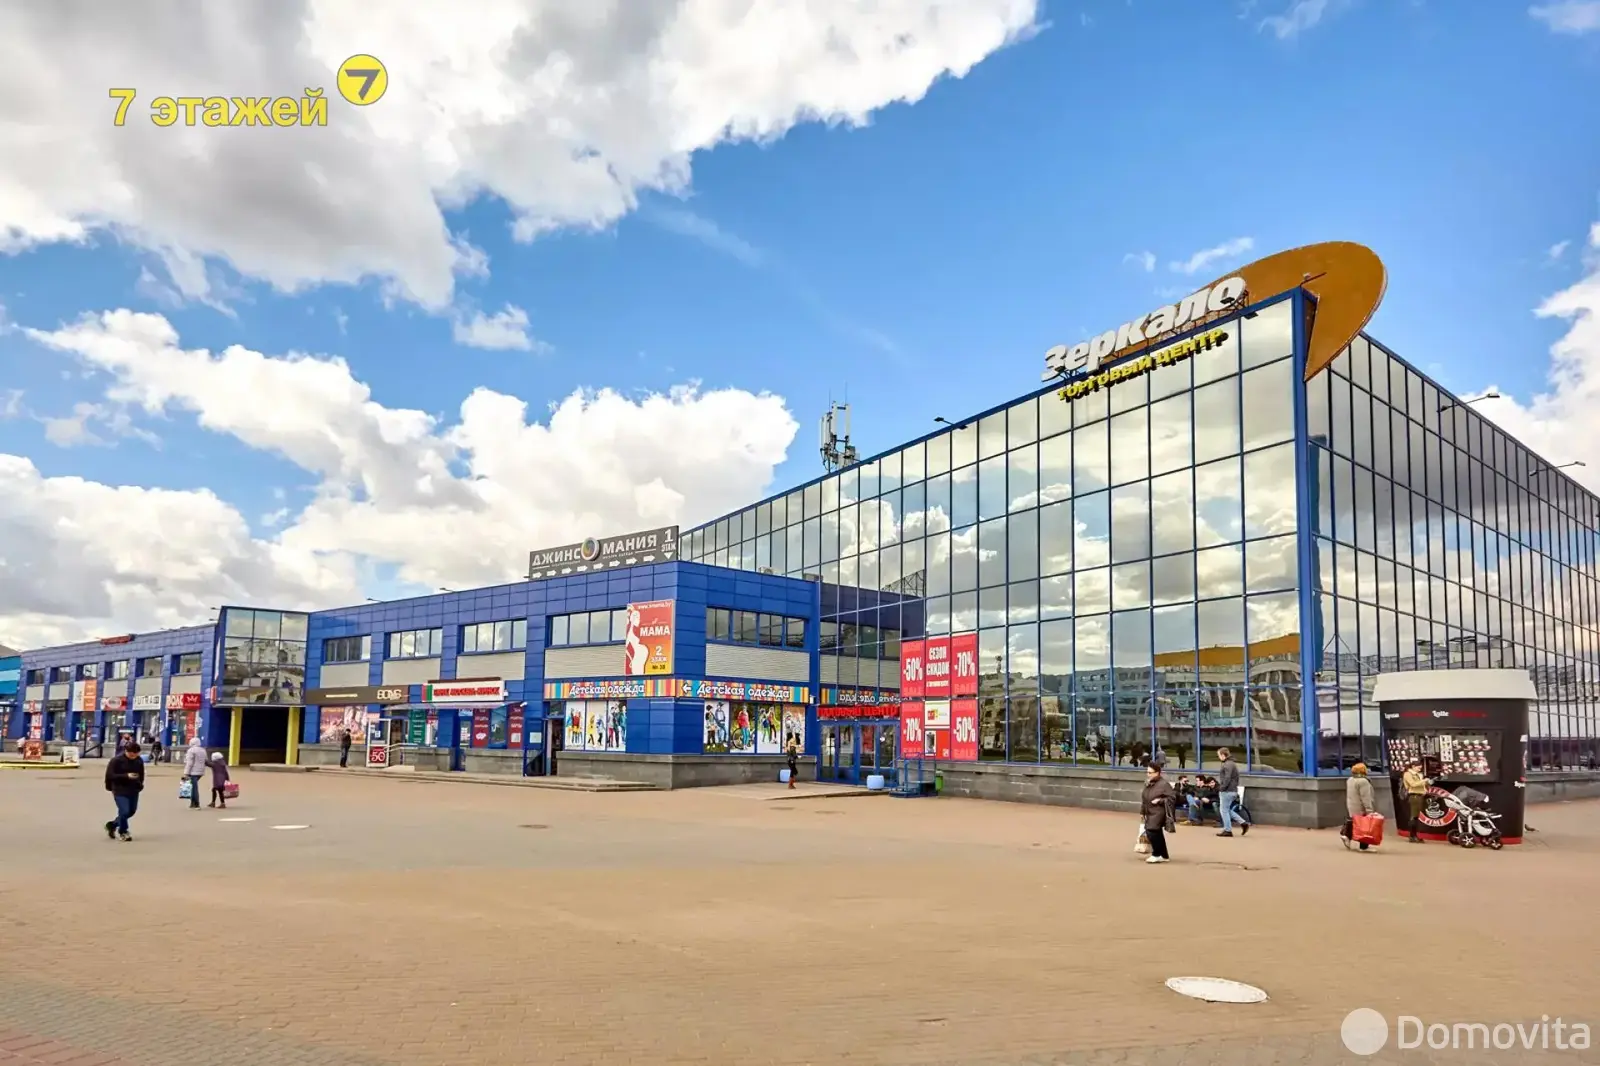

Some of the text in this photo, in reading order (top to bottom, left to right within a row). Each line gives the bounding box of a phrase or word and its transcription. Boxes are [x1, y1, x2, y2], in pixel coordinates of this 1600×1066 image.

[1041, 276, 1247, 382] Зеркало
[1057, 328, 1227, 402] ТОРГОВЫЙ ЦЕНТР
[664, 529, 673, 542] 1
[640, 625, 671, 637] МАМА
[655, 645, 663, 656] 2
[928, 646, 947, 660] СЕЗОН
[903, 657, 923, 681] -50%
[926, 661, 950, 677] СКИДОК
[954, 651, 976, 677] -70%
[569, 683, 645, 696] Детская одежда
[696, 683, 790, 698] Детская одежда
[903, 717, 922, 742] -70%
[953, 717, 976, 742] -50%
